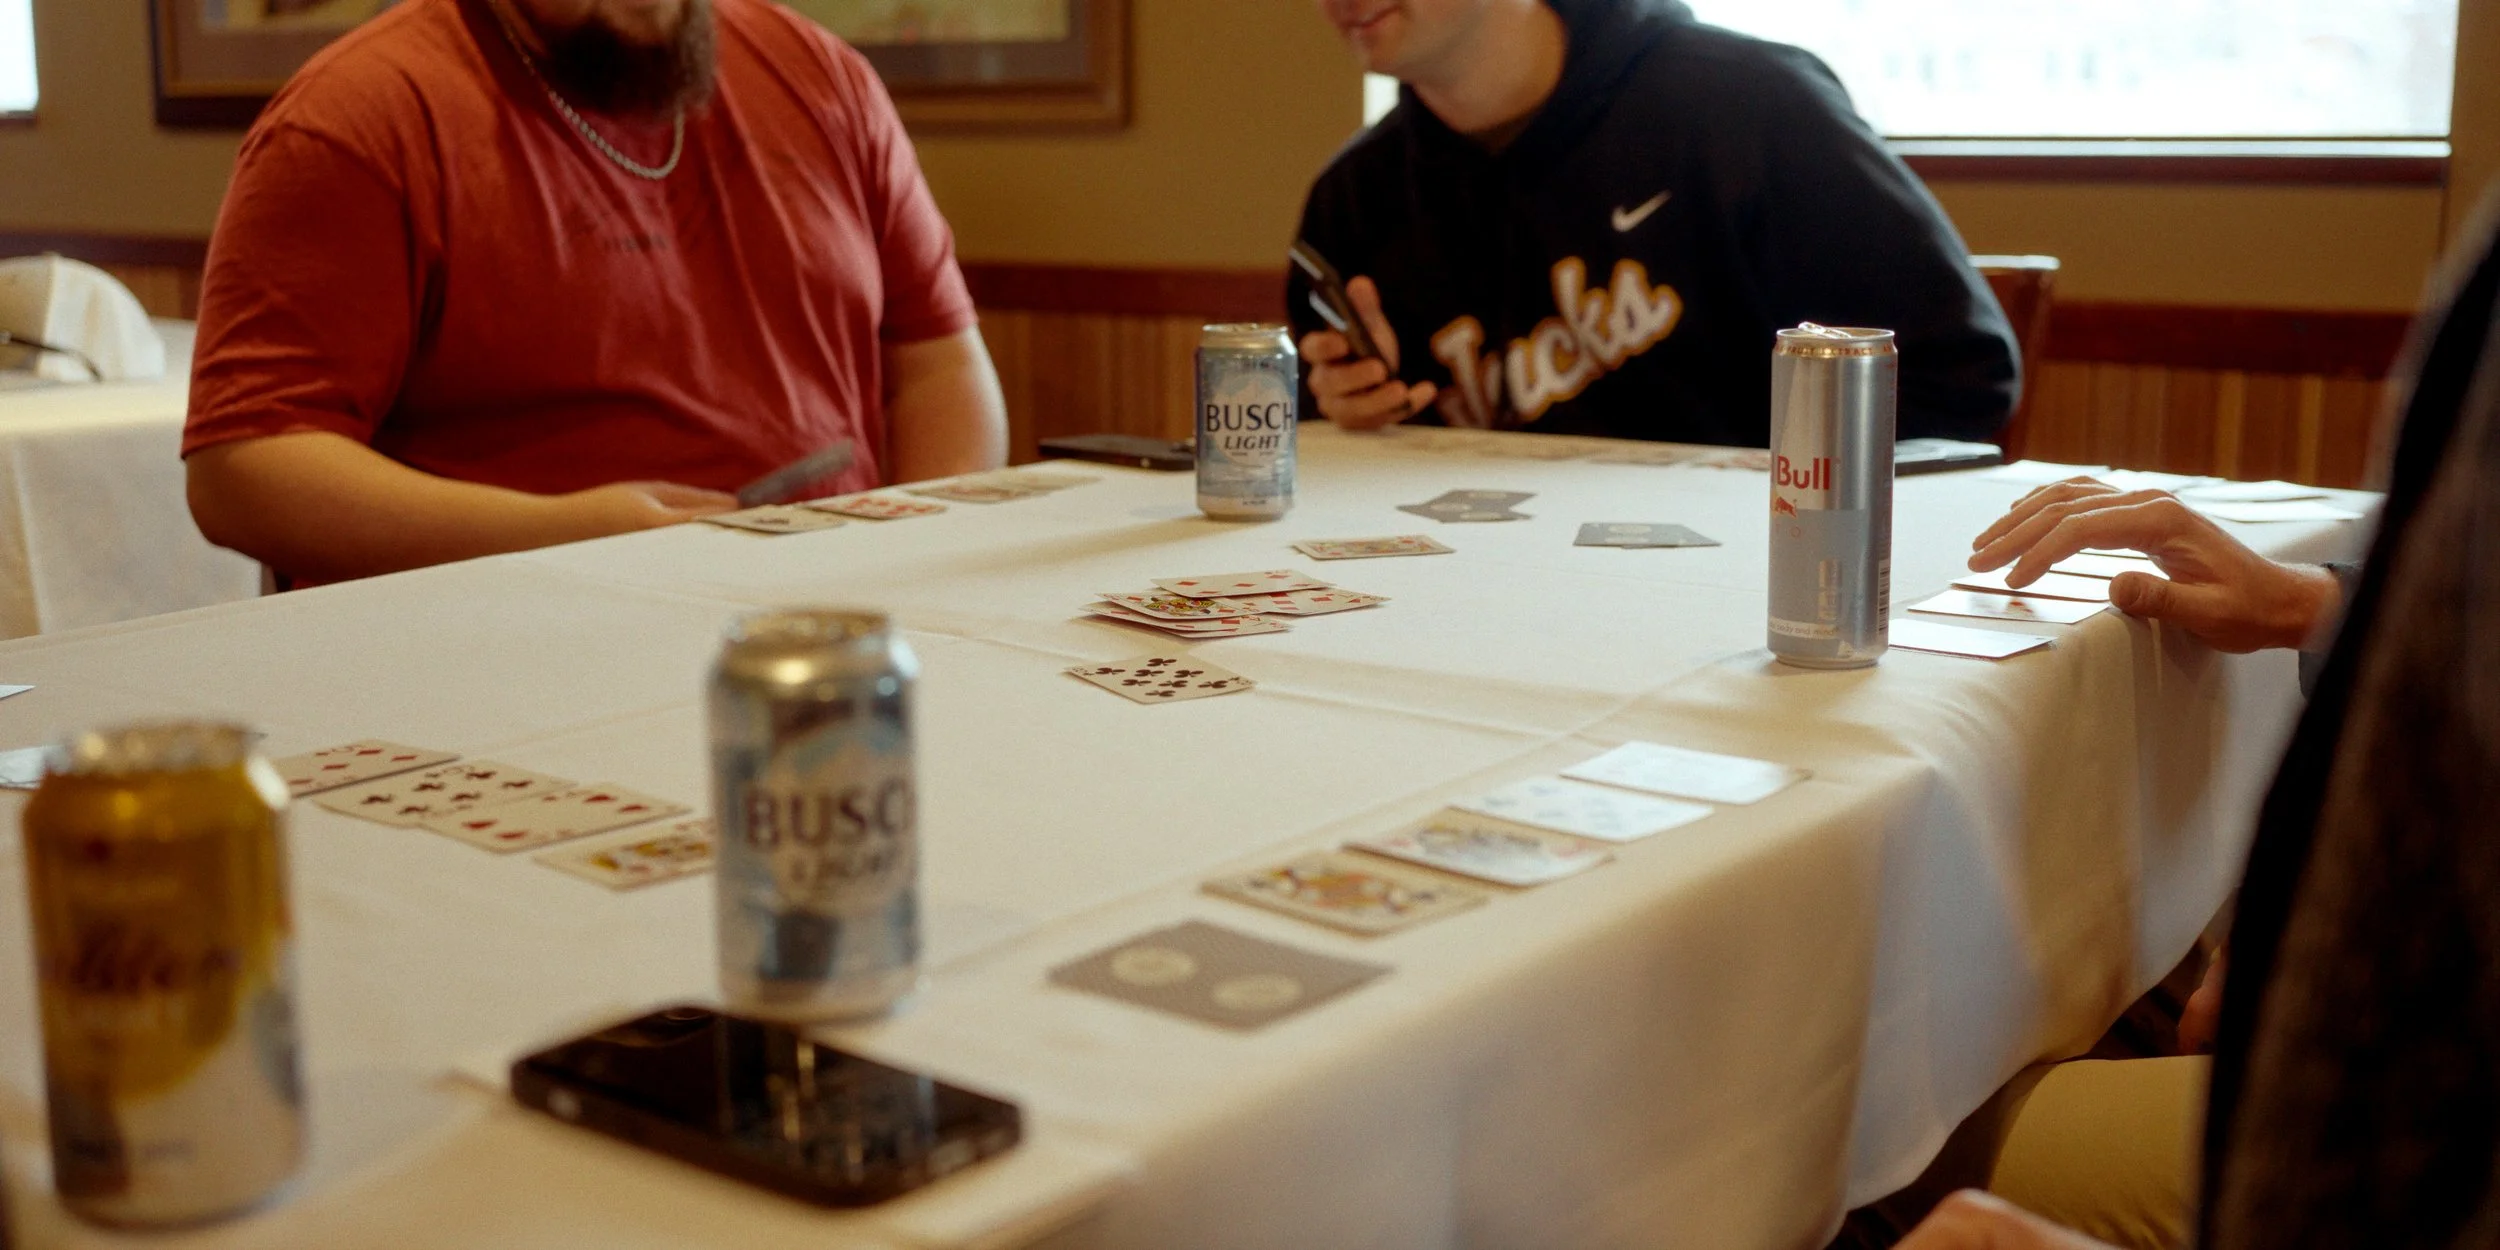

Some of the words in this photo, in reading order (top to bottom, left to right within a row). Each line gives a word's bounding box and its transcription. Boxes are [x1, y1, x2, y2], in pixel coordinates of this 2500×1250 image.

[1206, 402, 1293, 432] BUSCH
[1224, 435, 1281, 450] LIGHT
[1777, 455, 1831, 490] Bull
[745, 774, 914, 853] BUSC
